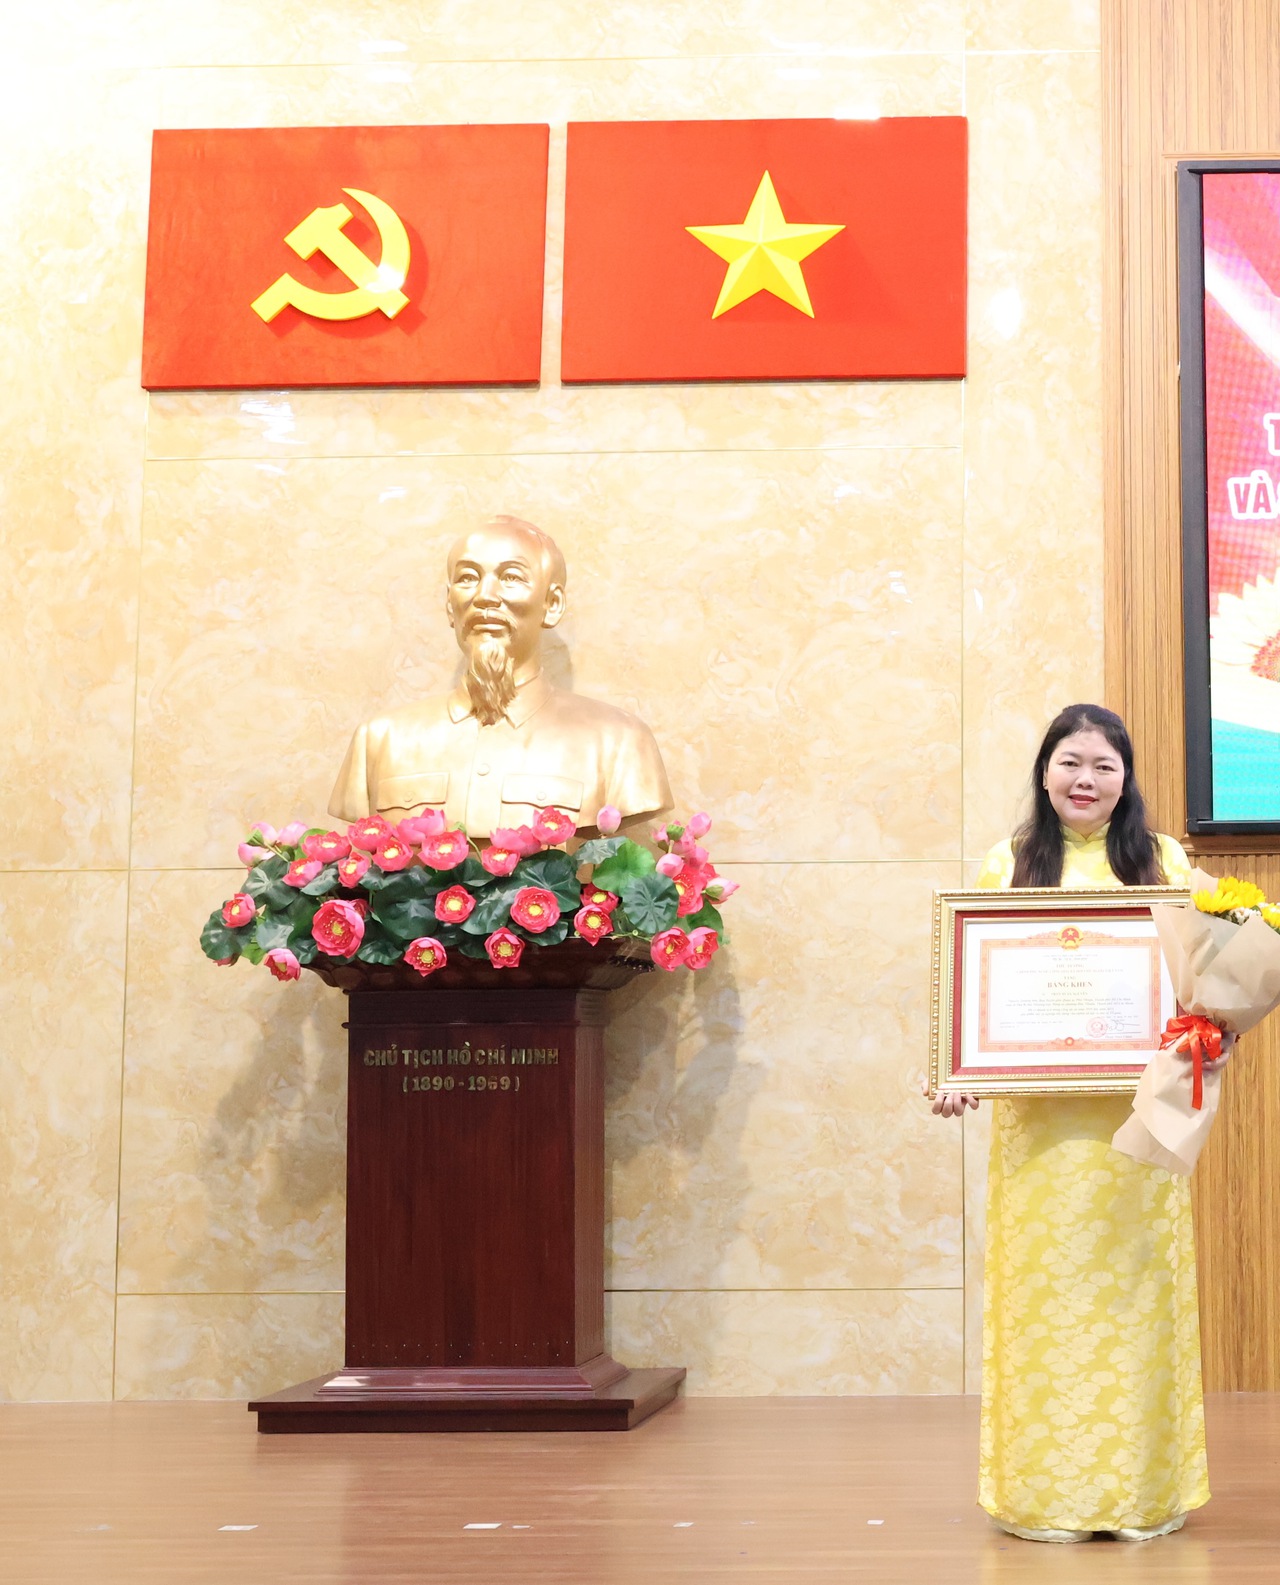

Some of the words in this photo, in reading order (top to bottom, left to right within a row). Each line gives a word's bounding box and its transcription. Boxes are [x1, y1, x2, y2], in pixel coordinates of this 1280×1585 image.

[1233, 476, 1271, 513] VÀ
[363, 1043, 398, 1066] CHỦ
[402, 1049, 443, 1068] TỊCH
[447, 1041, 472, 1065] HỒ
[475, 1044, 506, 1065] CHÍ
[511, 1048, 559, 1065] MINH
